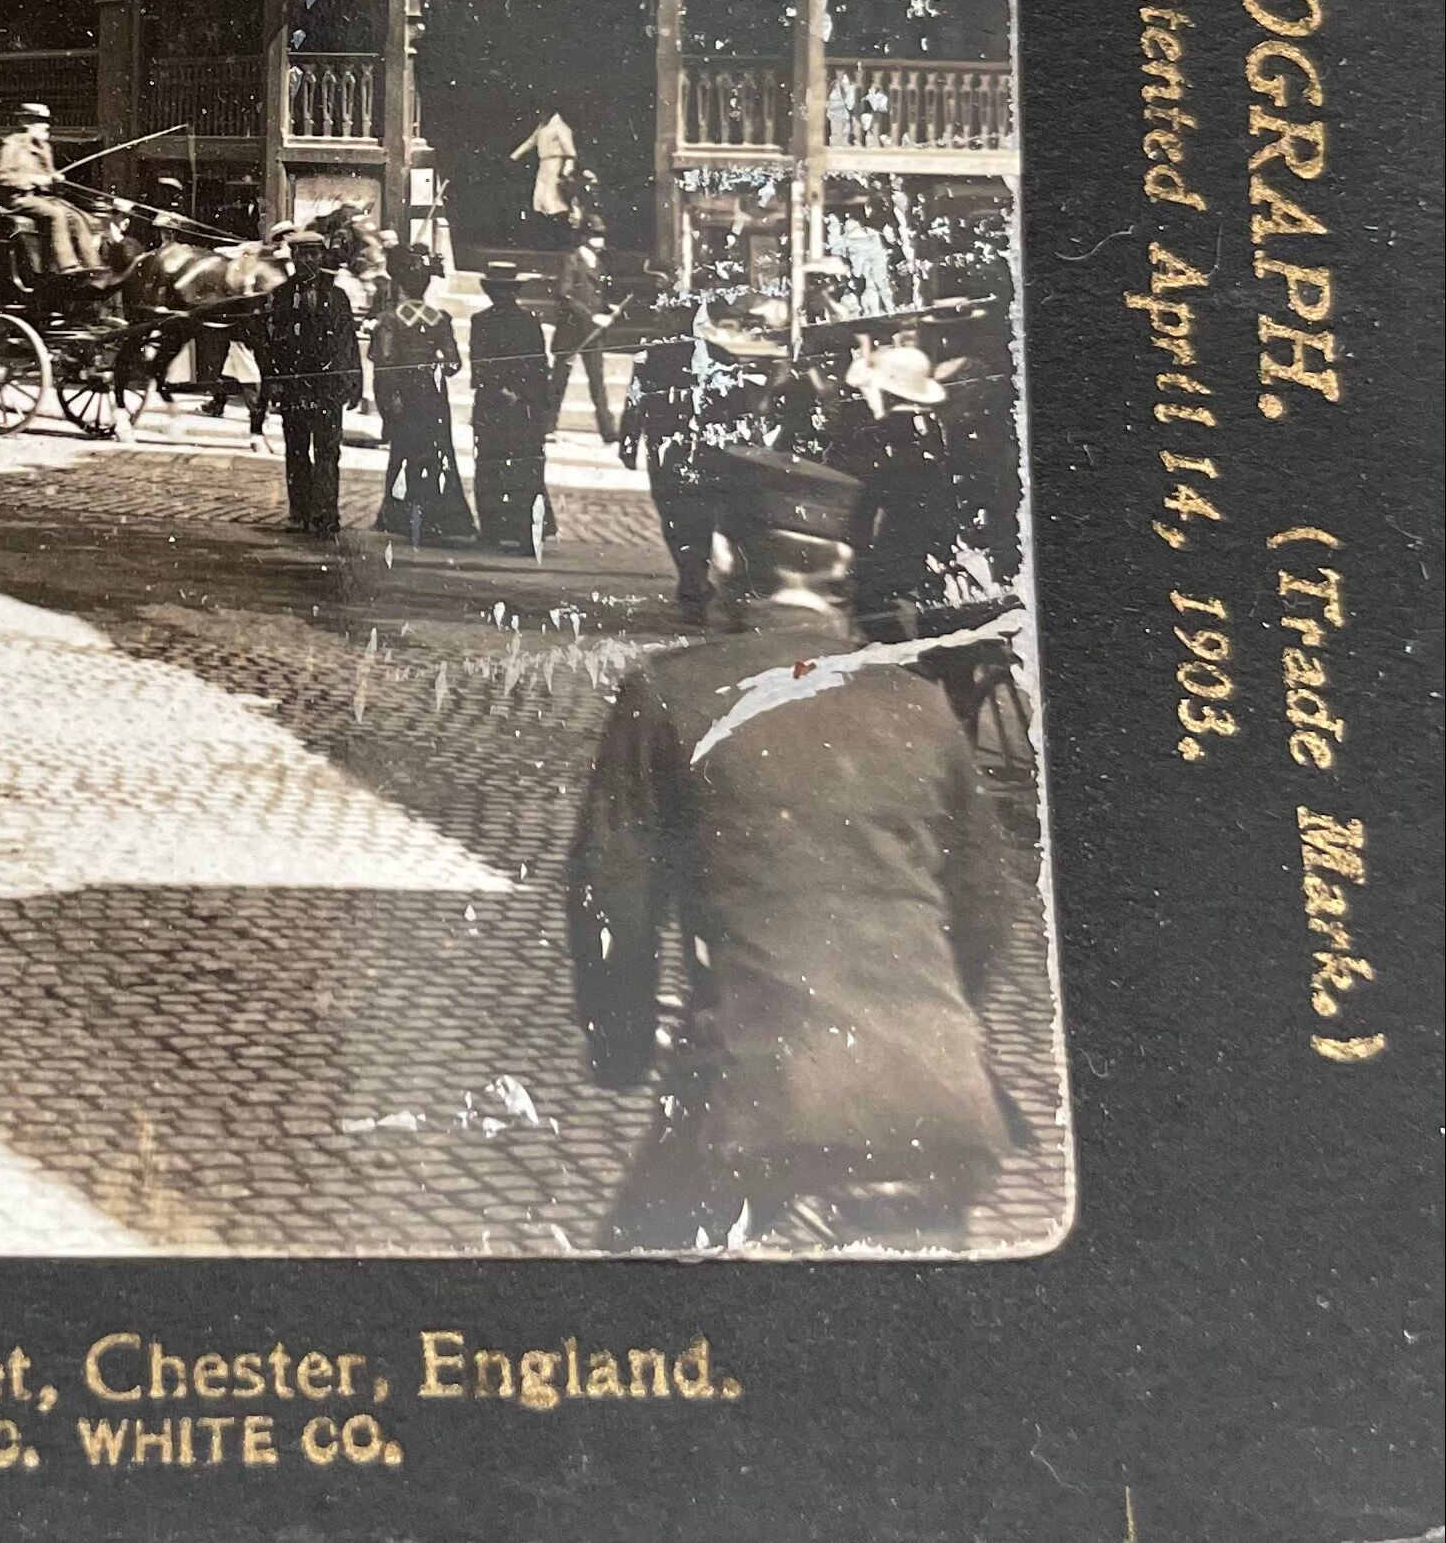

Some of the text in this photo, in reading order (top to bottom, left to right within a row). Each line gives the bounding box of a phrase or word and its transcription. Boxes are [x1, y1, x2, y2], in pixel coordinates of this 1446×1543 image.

[1123, 241, 1218, 427] April
[1153, 450, 1222, 549] 14,
[84, 1332, 391, 1404] Chester,
[417, 1330, 742, 1409] England.
[77, 1414, 280, 1468] WHITE
[300, 1413, 404, 1467] CO.
